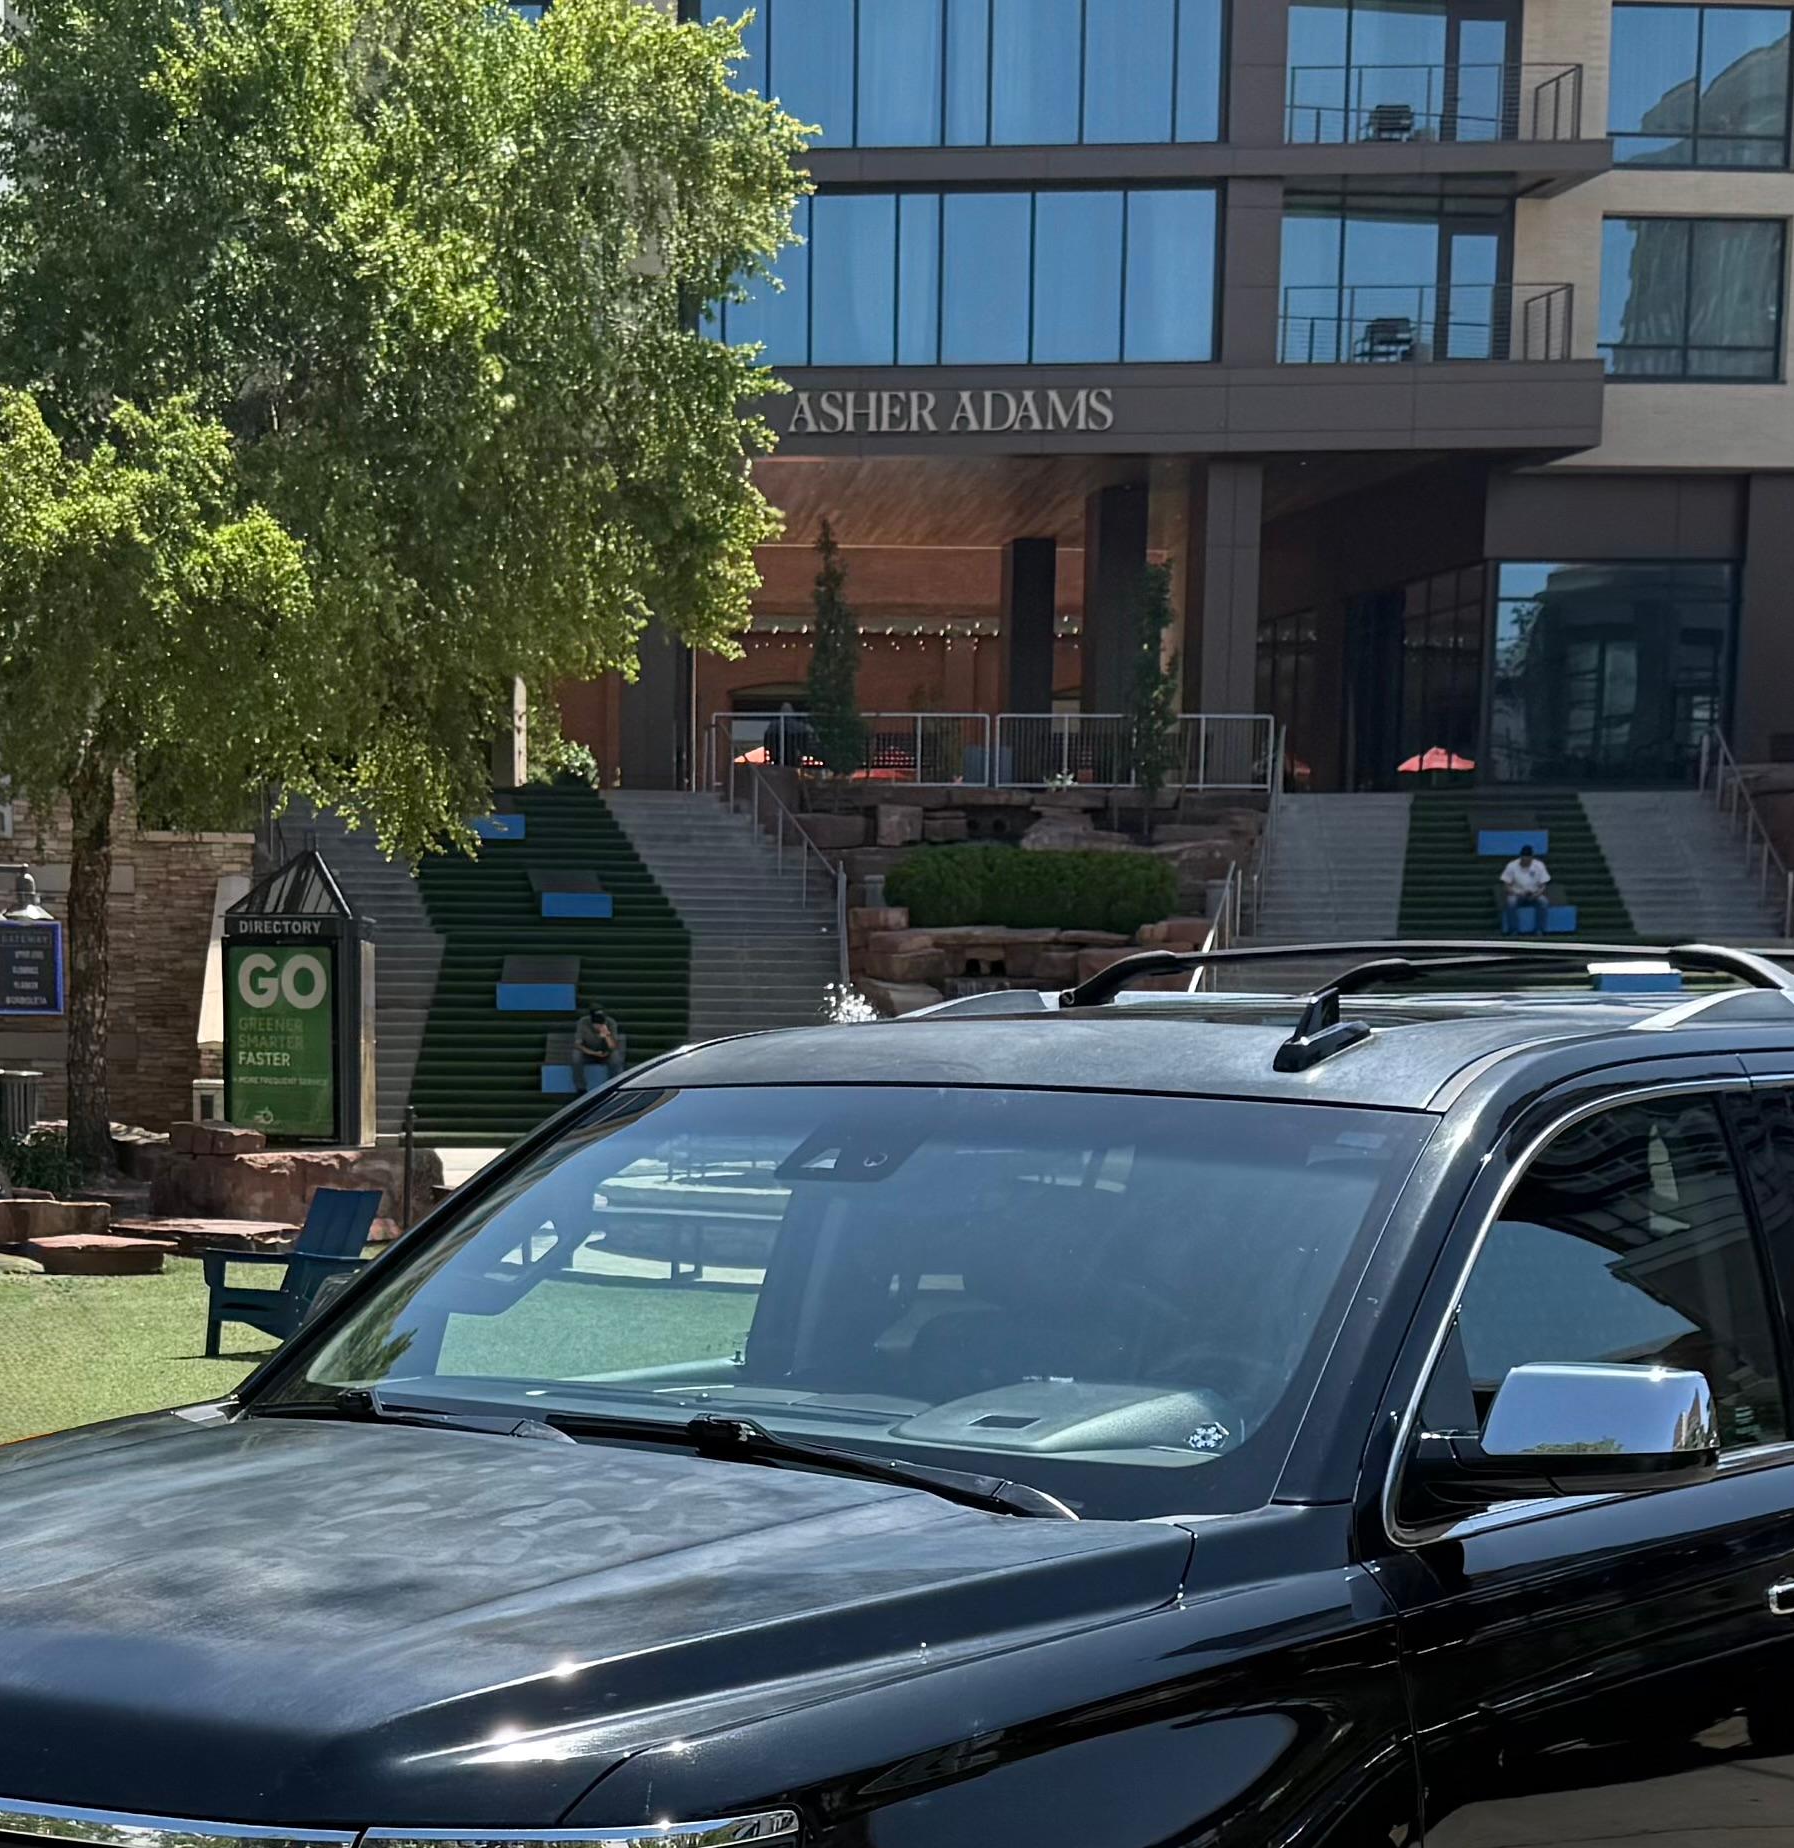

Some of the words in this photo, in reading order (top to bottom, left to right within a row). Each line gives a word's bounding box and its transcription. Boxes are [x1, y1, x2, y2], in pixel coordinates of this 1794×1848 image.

[788, 391, 938, 432] ASHER
[950, 388, 1114, 431] ADAMS
[239, 920, 322, 934] DIRECTORY
[238, 953, 327, 1009] GO
[238, 1017, 304, 1032] GREENER
[238, 1034, 304, 1049] SMARTER
[238, 1051, 291, 1067] FASTER
